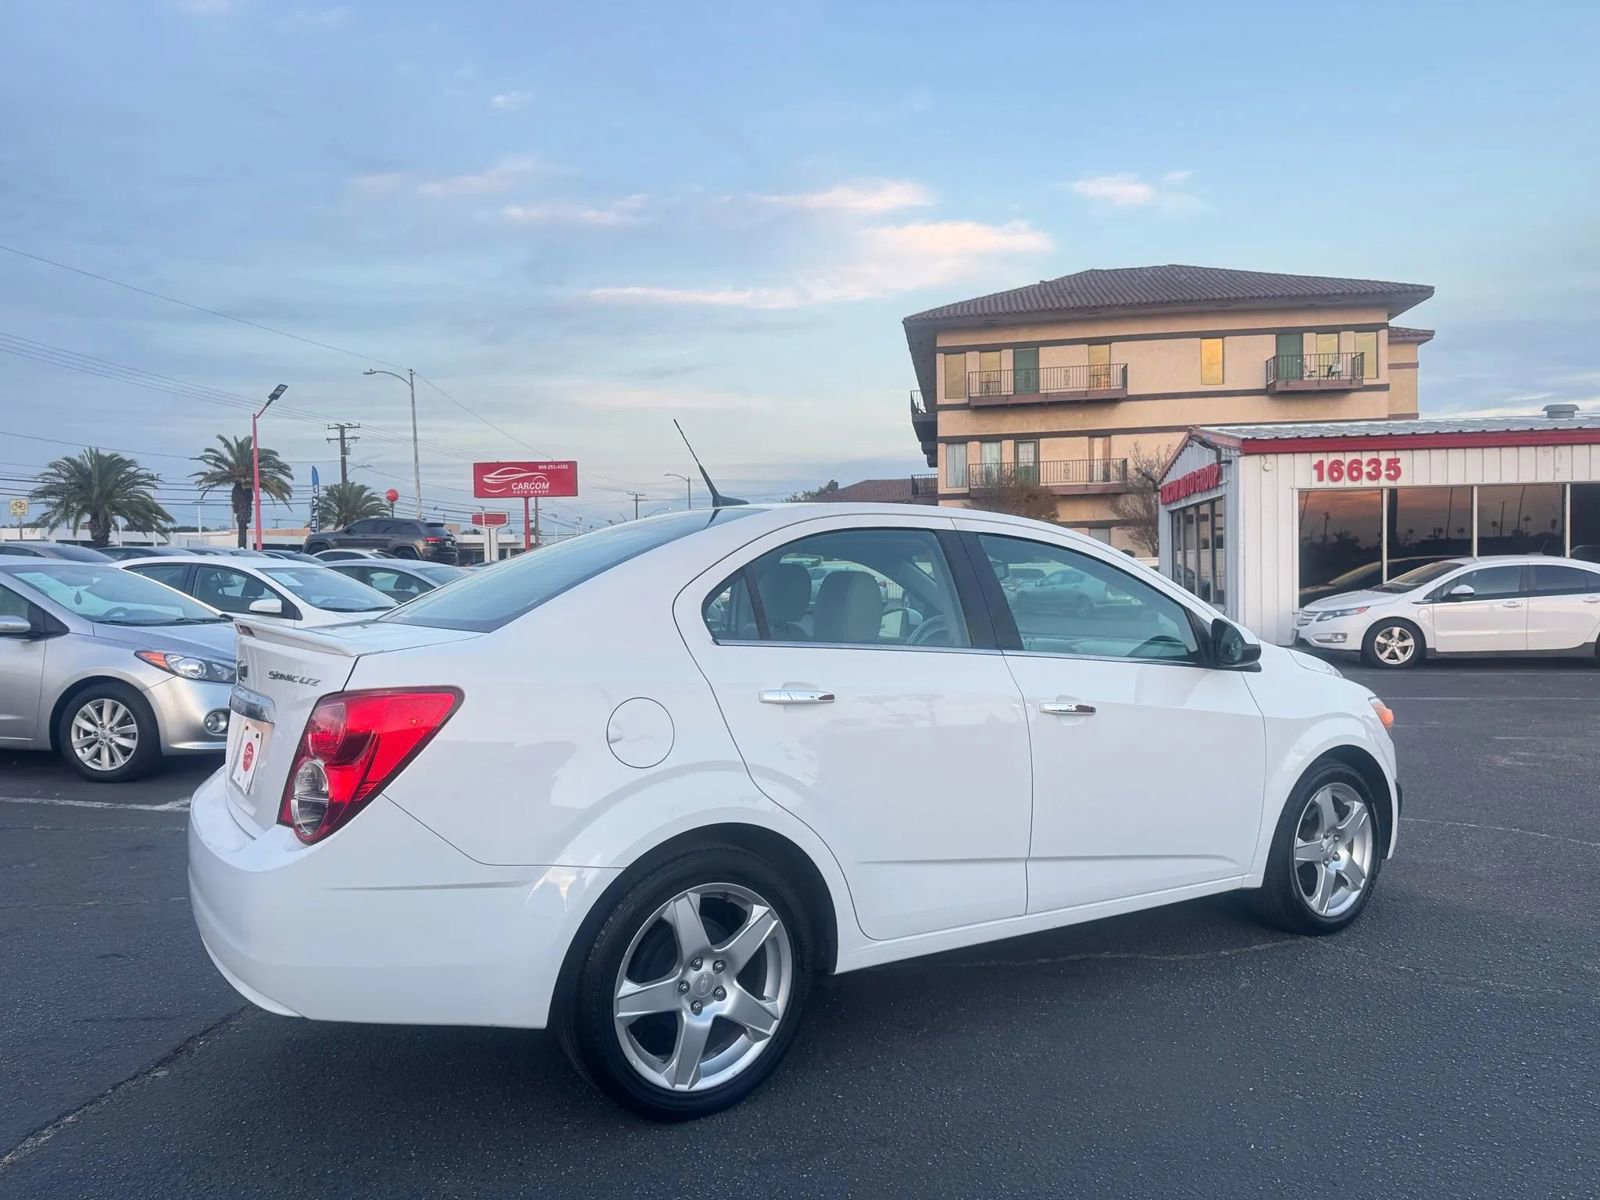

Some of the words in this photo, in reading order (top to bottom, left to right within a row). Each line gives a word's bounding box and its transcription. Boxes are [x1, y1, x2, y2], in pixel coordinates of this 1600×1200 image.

[1195, 463, 1219, 493] GROUP
[1313, 458, 1402, 482] 16635
[512, 482, 550, 490] CARCOM
